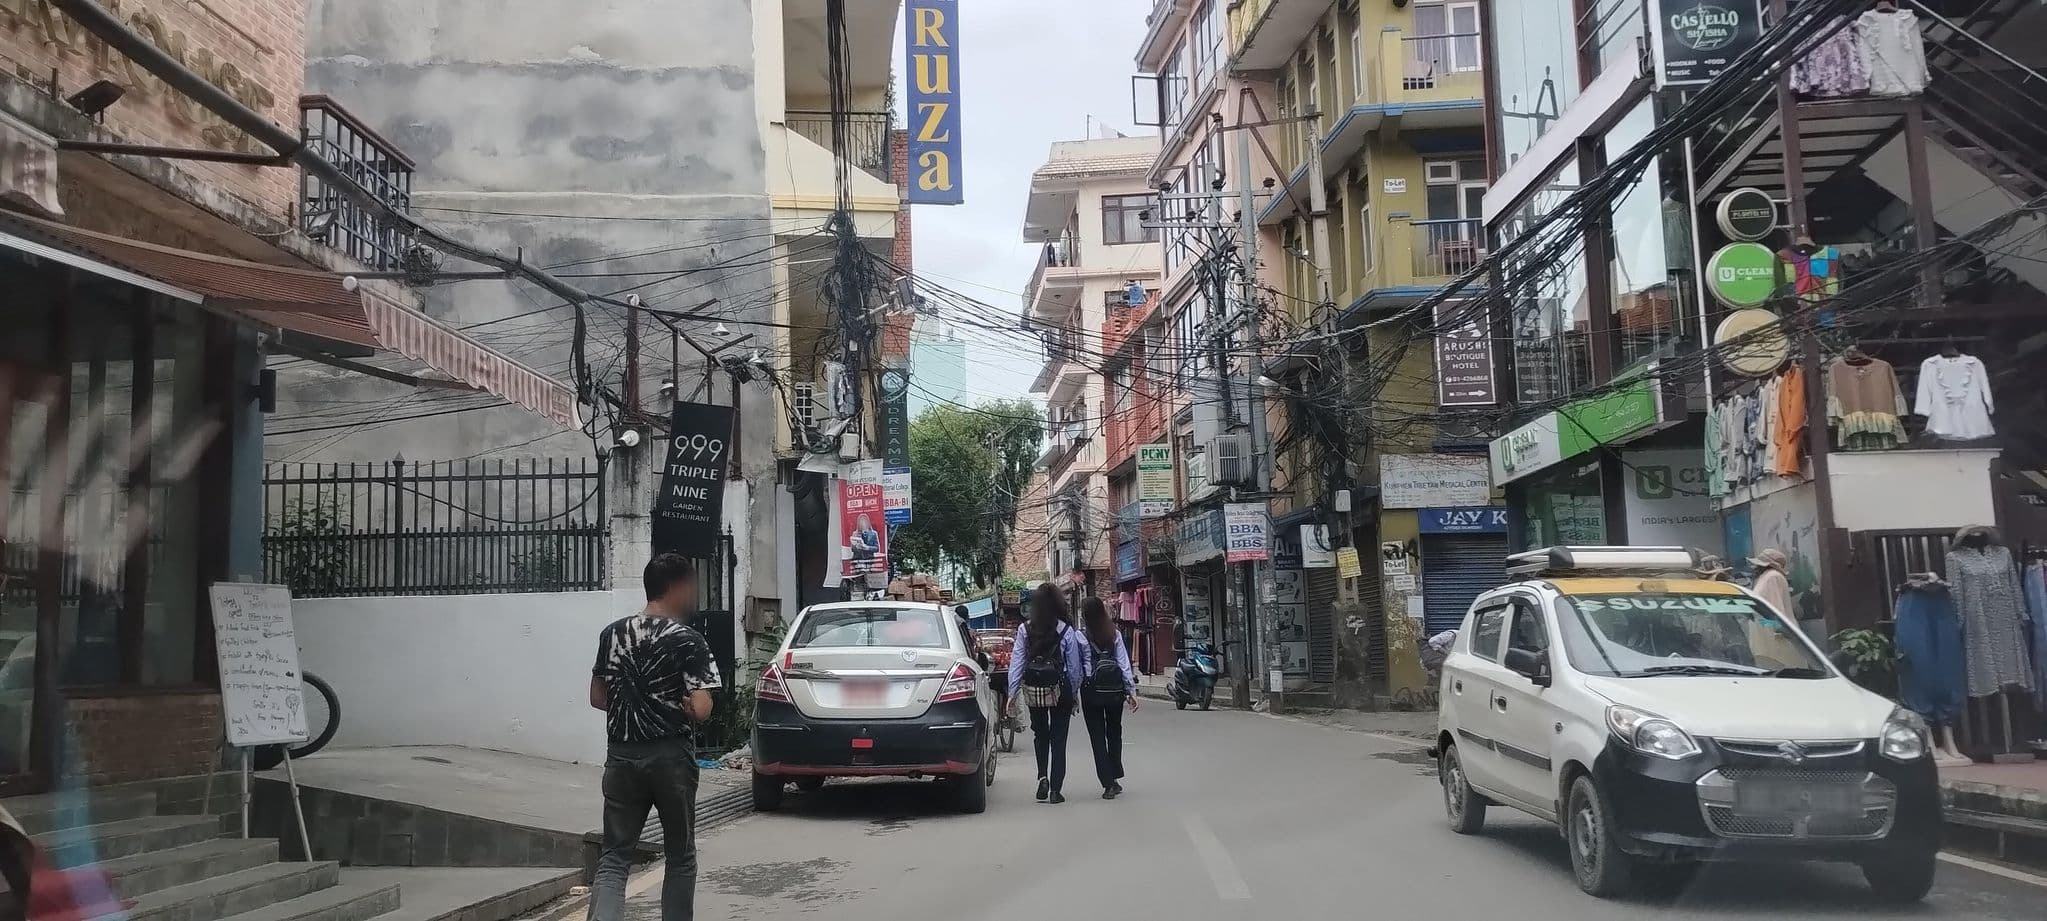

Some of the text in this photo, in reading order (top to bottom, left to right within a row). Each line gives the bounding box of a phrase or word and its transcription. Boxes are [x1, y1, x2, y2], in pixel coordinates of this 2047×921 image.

[674, 434, 723, 462] 999
[671, 464, 719, 480] TRIPLE
[672, 484, 708, 500] NINE
[847, 483, 879, 498] OPEN
[672, 502, 703, 512] GARDEN
[662, 510, 710, 522] RESTAURANT
[1440, 510, 1483, 525] JAY
[1230, 524, 1262, 533] BBA
[1231, 539, 1262, 548] BBS
